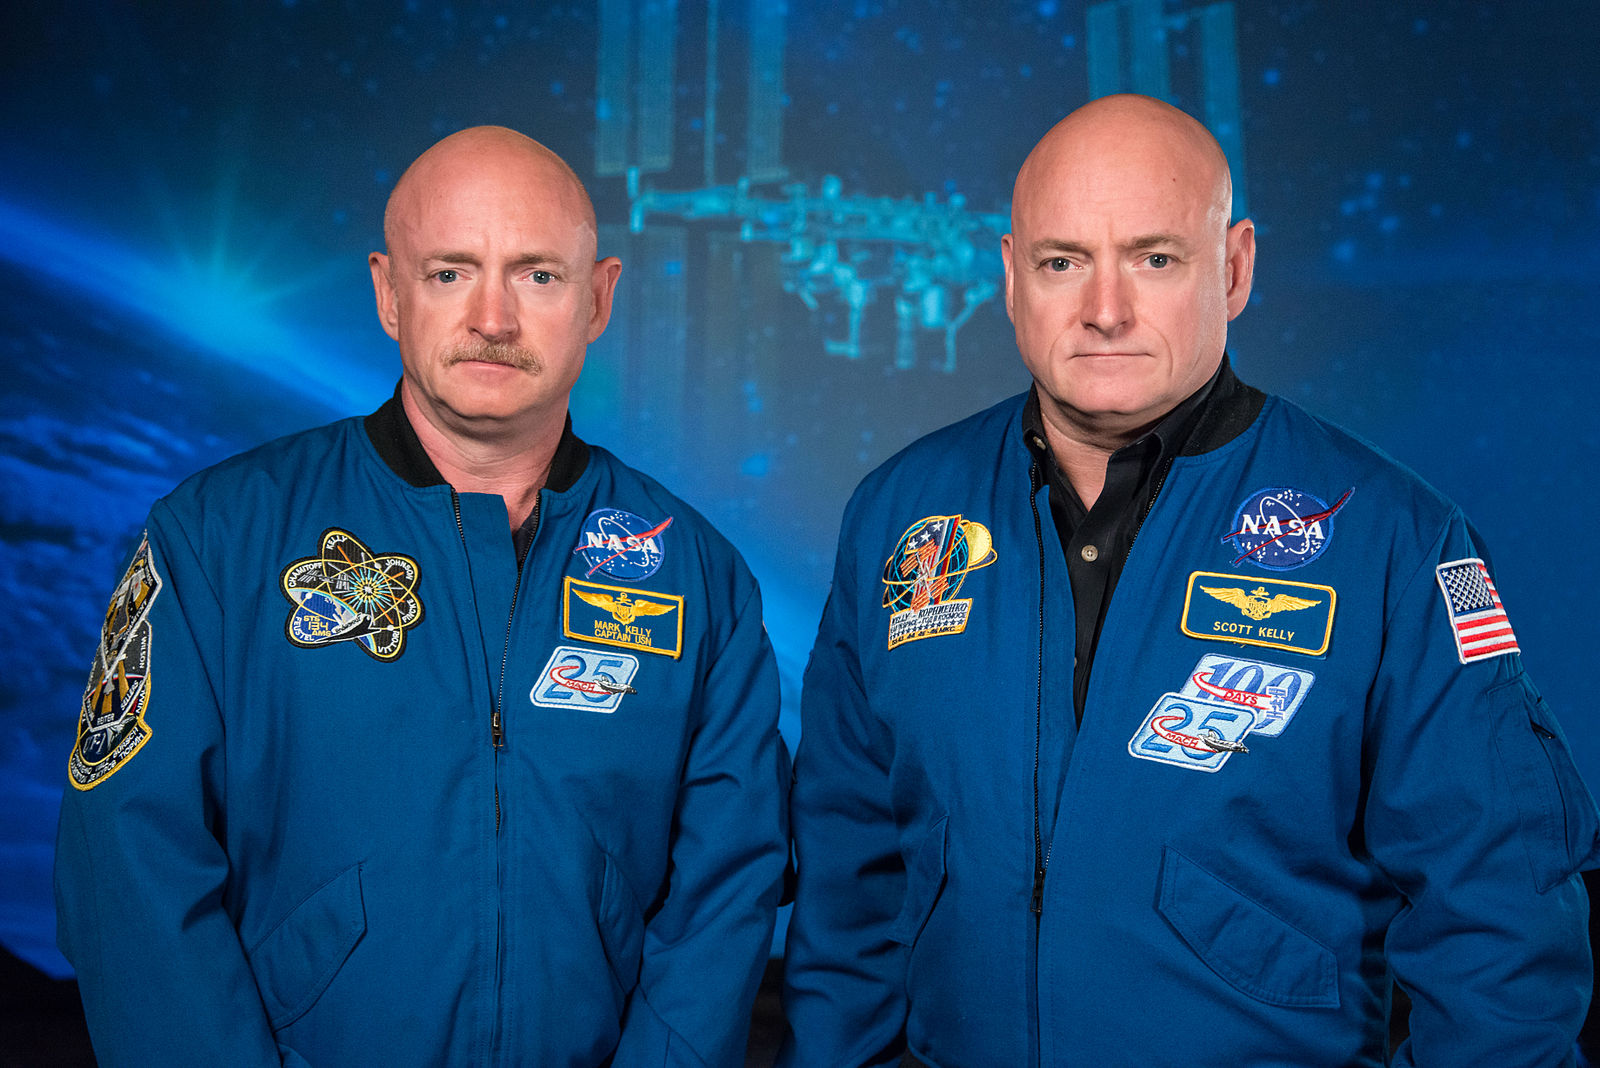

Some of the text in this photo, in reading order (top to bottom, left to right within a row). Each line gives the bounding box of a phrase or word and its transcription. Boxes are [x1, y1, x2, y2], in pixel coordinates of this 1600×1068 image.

[1240, 514, 1325, 539] NASA
[326, 535, 348, 550] KELLY
[586, 532, 660, 554] NASA
[385, 558, 414, 580] JOHNSON
[402, 598, 417, 623] FINCKE
[293, 616, 315, 641] FEUSTEL
[308, 621, 329, 631] 134
[594, 620, 652, 637] MARK KELLY
[1213, 621, 1295, 642] SCOTT KELLY
[377, 630, 400, 654] VITTORI
[594, 629, 652, 646] CAPTAIN USN
[139, 636, 148, 669] WILSON
[543, 655, 624, 703] 25
[565, 680, 595, 691] MACH
[1196, 662, 1301, 729] 100
[1223, 690, 1258, 705] DAYS
[1141, 703, 1238, 760] 25
[1166, 732, 1199, 748] MACH
